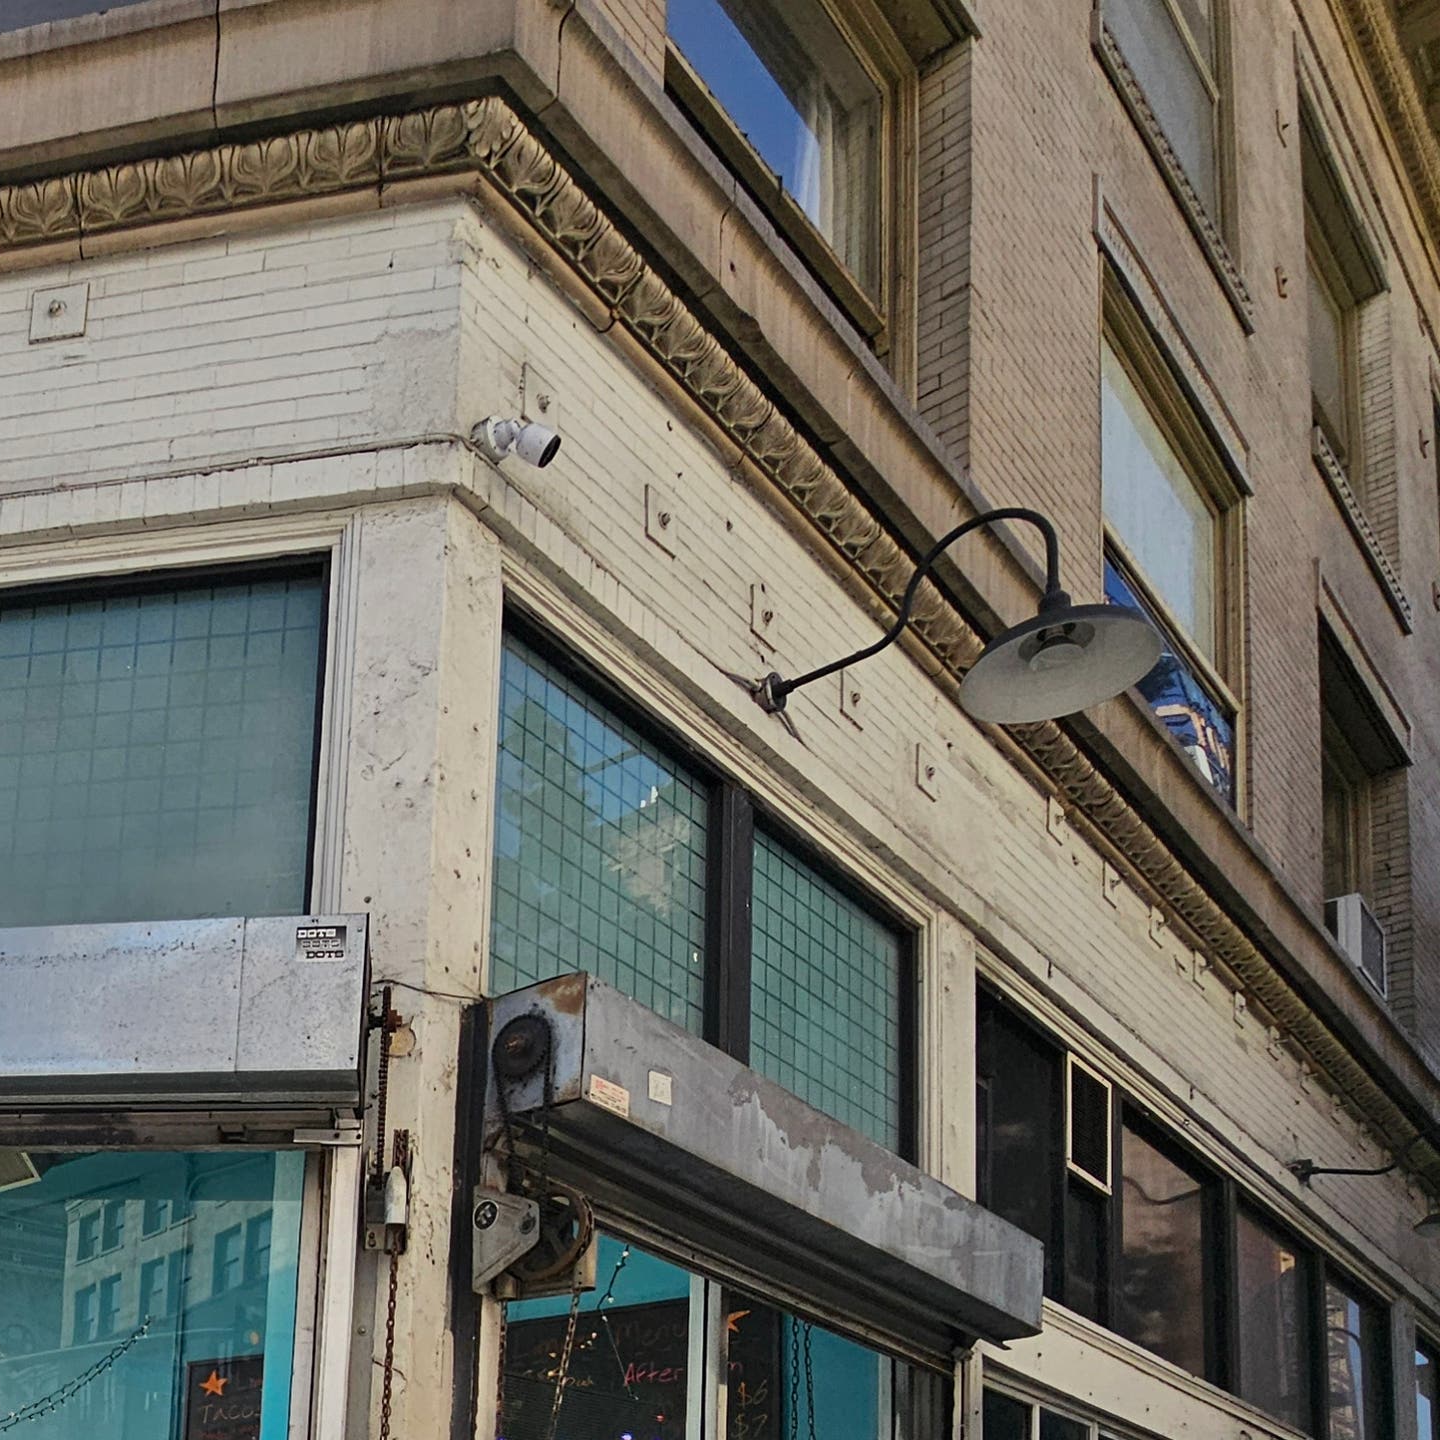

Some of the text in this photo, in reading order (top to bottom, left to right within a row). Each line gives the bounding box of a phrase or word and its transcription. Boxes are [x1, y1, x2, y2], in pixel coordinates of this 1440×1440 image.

[306, 950, 344, 958] DOTS
[624, 1362, 684, 1386] After
[737, 1380, 768, 1407] $6
[731, 1413, 768, 1440] $7
